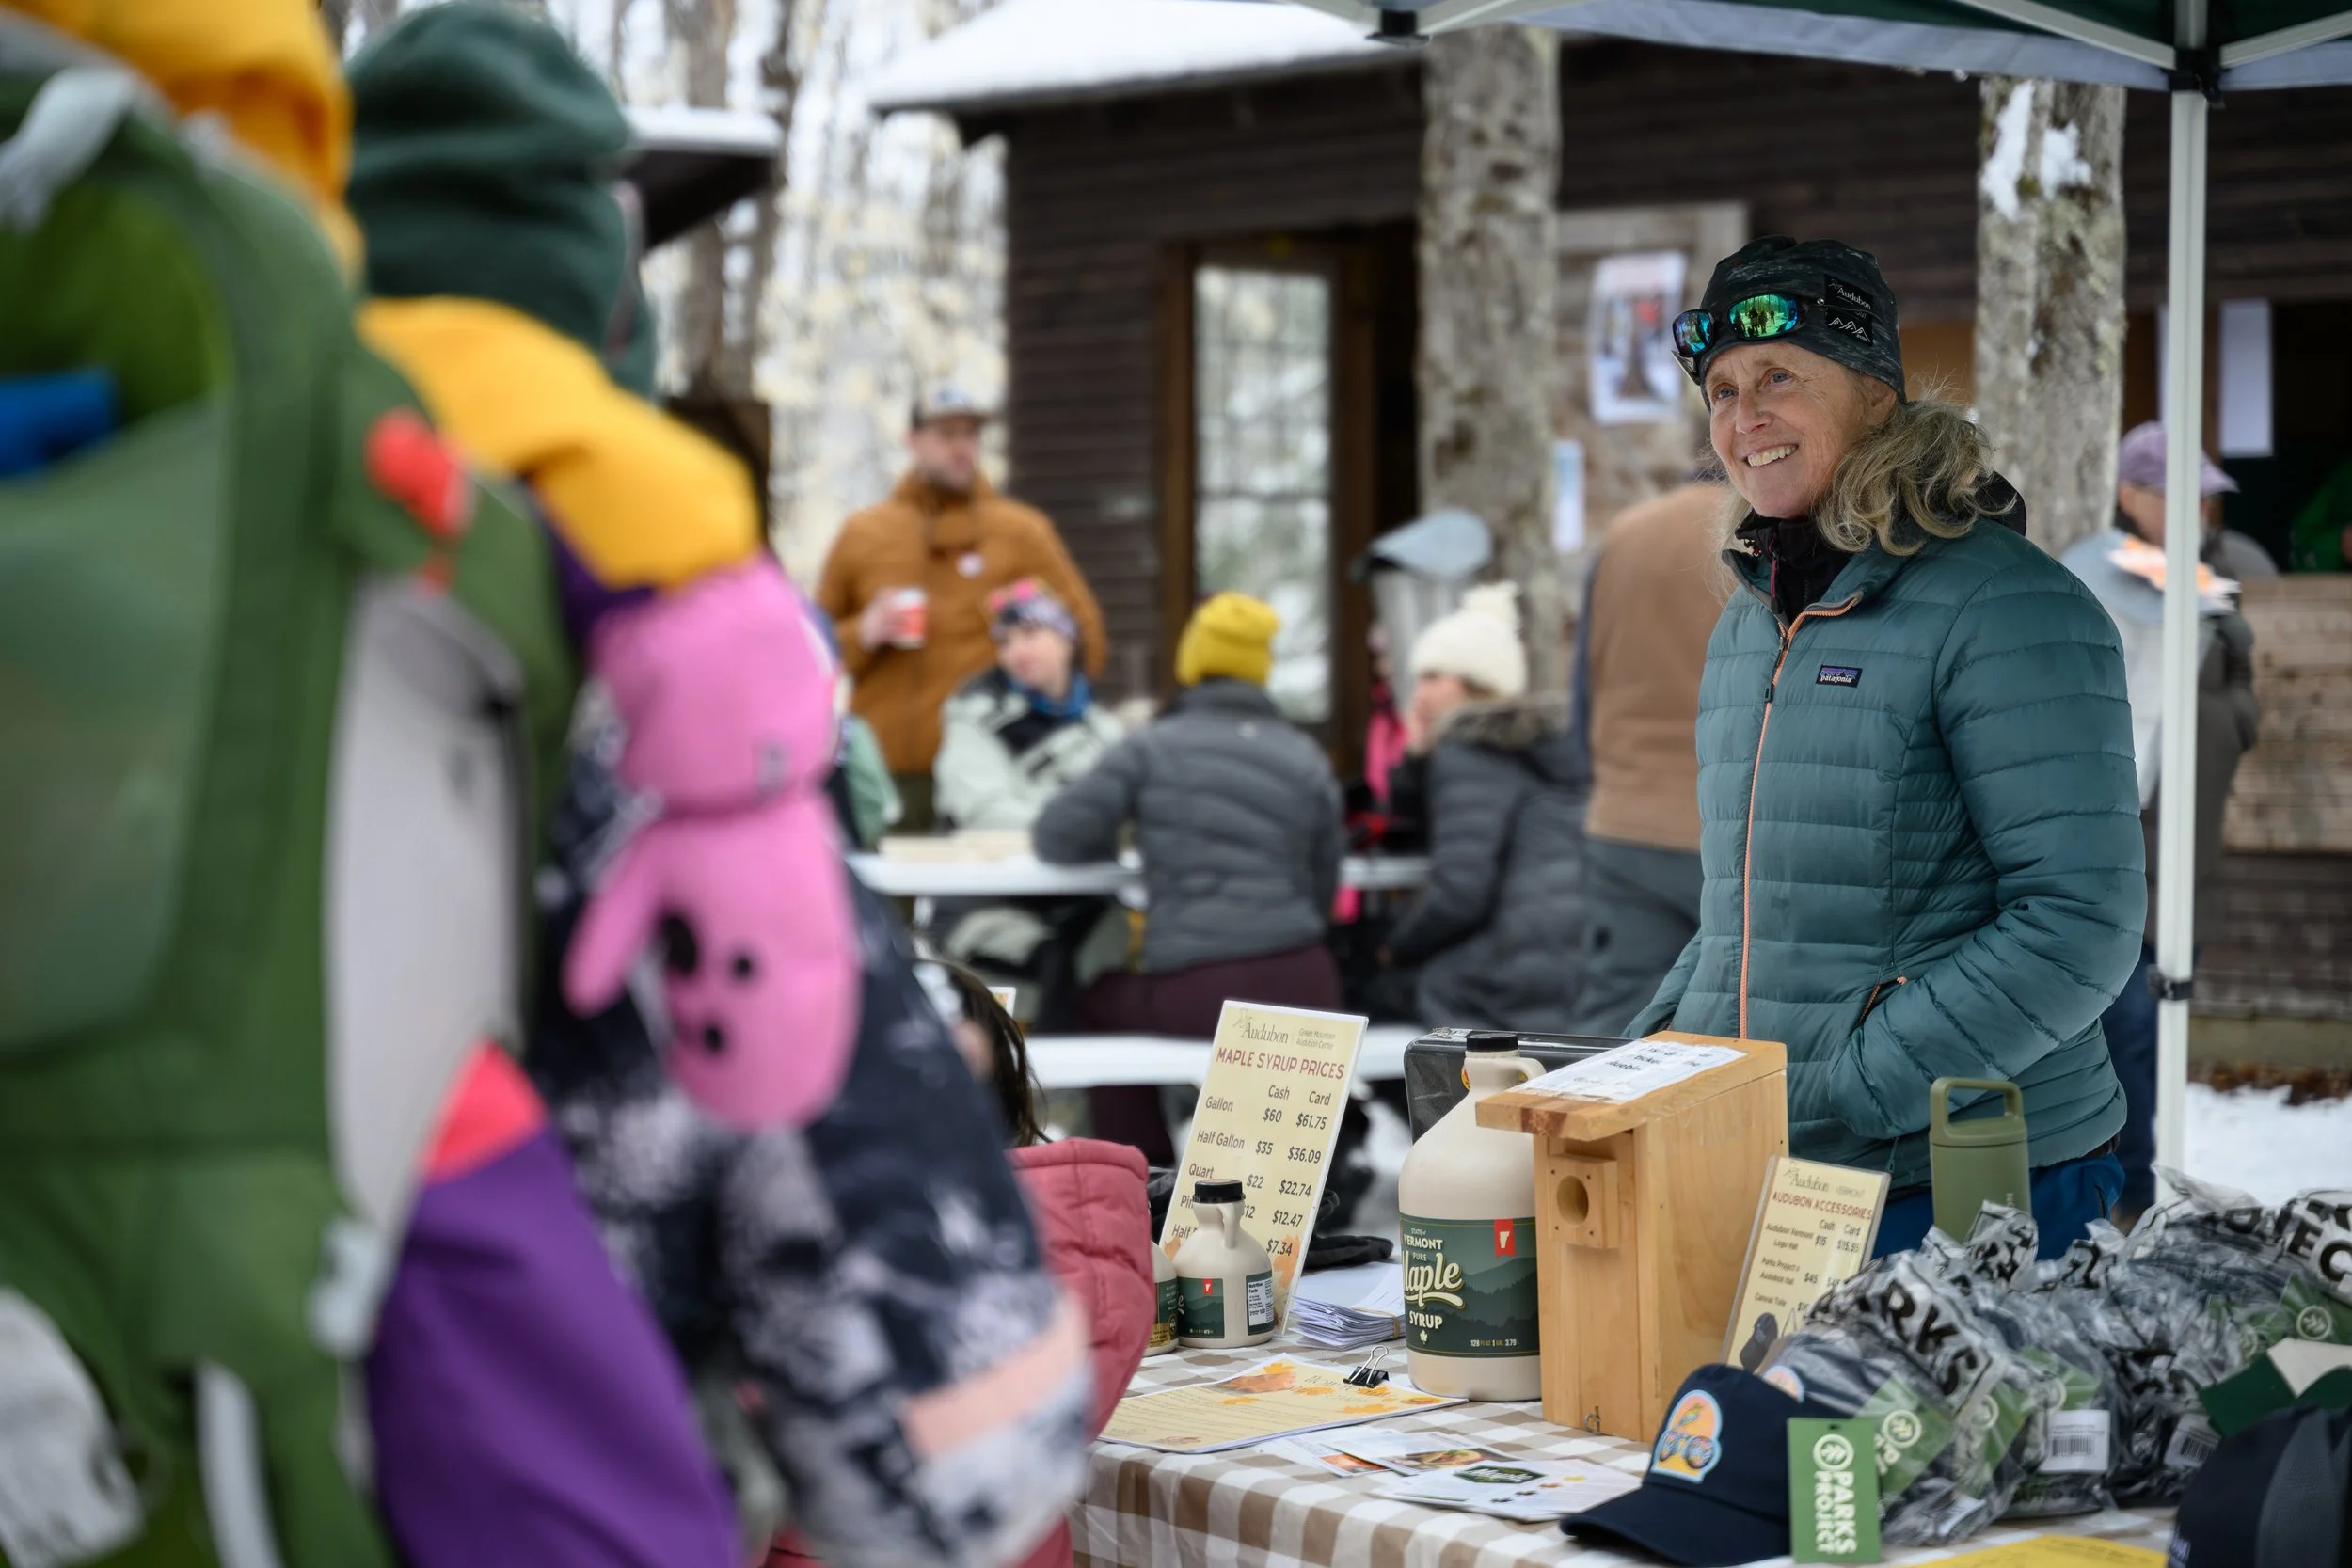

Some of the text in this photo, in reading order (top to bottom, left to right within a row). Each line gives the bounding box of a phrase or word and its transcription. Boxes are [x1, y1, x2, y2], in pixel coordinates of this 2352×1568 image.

[1836, 287, 1871, 309] Audubon
[1820, 674, 1852, 683] patagonia
[1241, 1022, 1289, 1044] Audubon
[1296, 1037, 1334, 1050] Audubon Center
[1216, 1047, 1344, 1079] MAPLE SYRUP PRICES
[1268, 1085, 1331, 1106] Cash Card
[1205, 1096, 1327, 1131] Gallon $60 $61.75
[1197, 1130, 1321, 1164] Half Gallon $35 $36.09
[1188, 1163, 1311, 1198] Quart $22 $22.74
[1789, 1173, 1830, 1193] Audubon
[1180, 1195, 1194, 1210] Pin
[1272, 1210, 1303, 1228] $12.47
[1772, 1191, 1872, 1220] AUDUBON ACCESSORIES
[1411, 1227, 1422, 1236] STATE
[1766, 1223, 1790, 1234] Audubon
[1790, 1227, 1815, 1240] Vermont
[1815, 1234, 1828, 1246] $15
[1819, 1219, 1861, 1236] Cash Card
[1171, 1225, 1294, 1257] Half $7.34
[1404, 1233, 1443, 1250] VERMONT
[1773, 1239, 1788, 1248] Logo
[1413, 1252, 1427, 1261] PURE
[1776, 1260, 1796, 1271] Project
[1760, 1272, 1784, 1282] Audubon
[1804, 1273, 1819, 1284] $45
[1755, 1292, 1774, 1305] Canvas
[1774, 1296, 1787, 1307] Tote
[1409, 1310, 1443, 1329] SYRUP
[1814, 1470, 1834, 1554] PROJECT
[1832, 1471, 1857, 1555] PARKS
